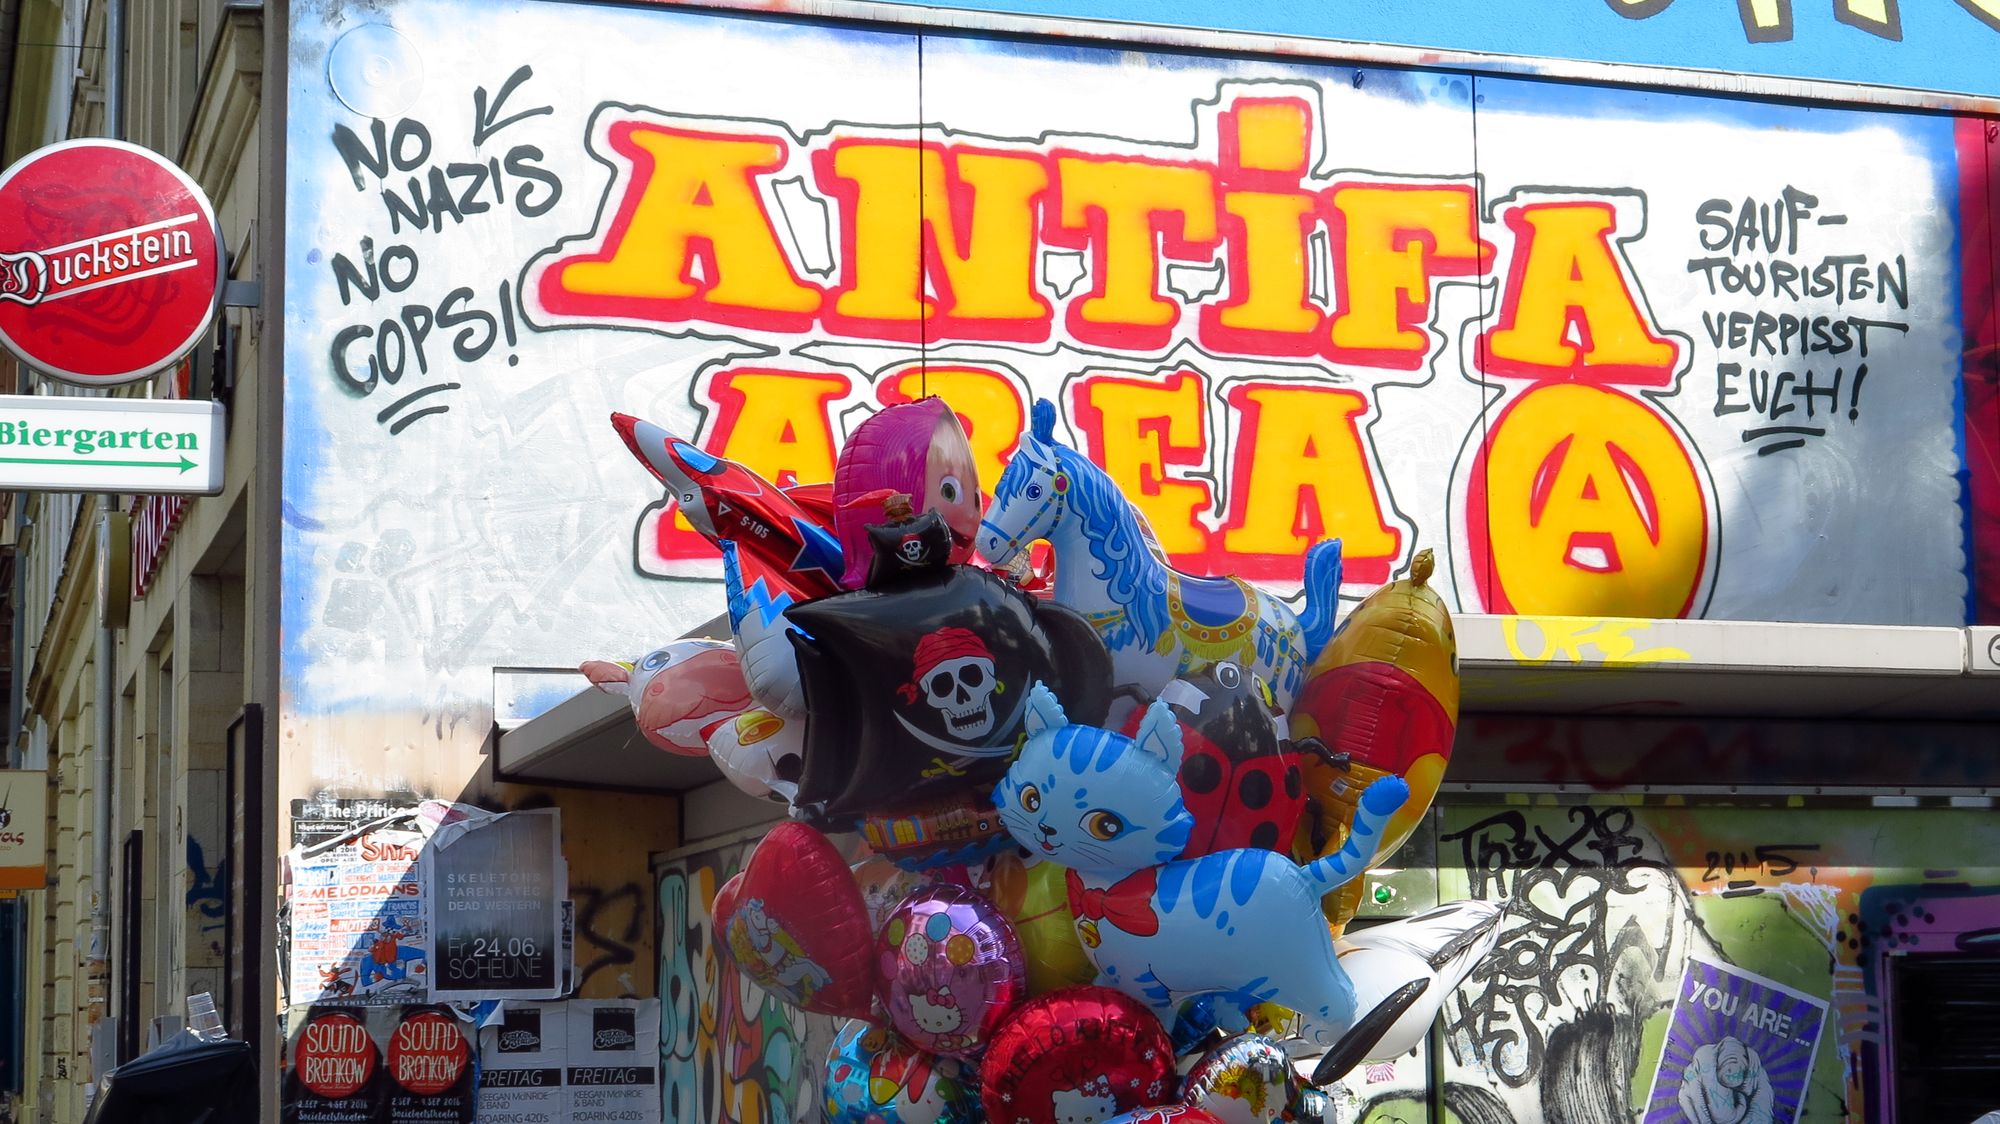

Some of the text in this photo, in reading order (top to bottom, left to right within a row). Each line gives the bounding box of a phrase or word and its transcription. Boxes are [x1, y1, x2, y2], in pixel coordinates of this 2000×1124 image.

[332, 117, 431, 192] NO
[382, 145, 562, 233] NAZIS
[1696, 185, 1848, 255] SAUF-
[331, 236, 418, 306] NO
[1687, 253, 1908, 309] TOURISTEN
[331, 280, 519, 397] COPS!
[1702, 310, 1909, 358] VERPISST
[1713, 363, 1868, 420] EUCH!
[740, 515, 770, 539] S-105
[322, 803, 351, 818] The
[311, 884, 420, 899] MELODIANS
[448, 901, 541, 911] DEAD WESTERN
[473, 937, 541, 957] 24.06.
[449, 958, 542, 979] SCHEUNE
[1689, 980, 1739, 1017] YOU
[1741, 1002, 1793, 1038] ARE
[306, 1023, 367, 1053] SOUND
[399, 1021, 459, 1051] SOUND
[305, 1057, 367, 1084] BRONKOW
[399, 1055, 459, 1081] BRONKOW
[480, 1070, 543, 1087] FREITAG
[573, 1067, 637, 1084] FREITAG
[479, 1101, 510, 1110] & BAND
[574, 1090, 606, 1099] KEEGAN
[478, 1112, 549, 1124] ROARING 420's
[573, 1110, 644, 1121] ROARING 420's
